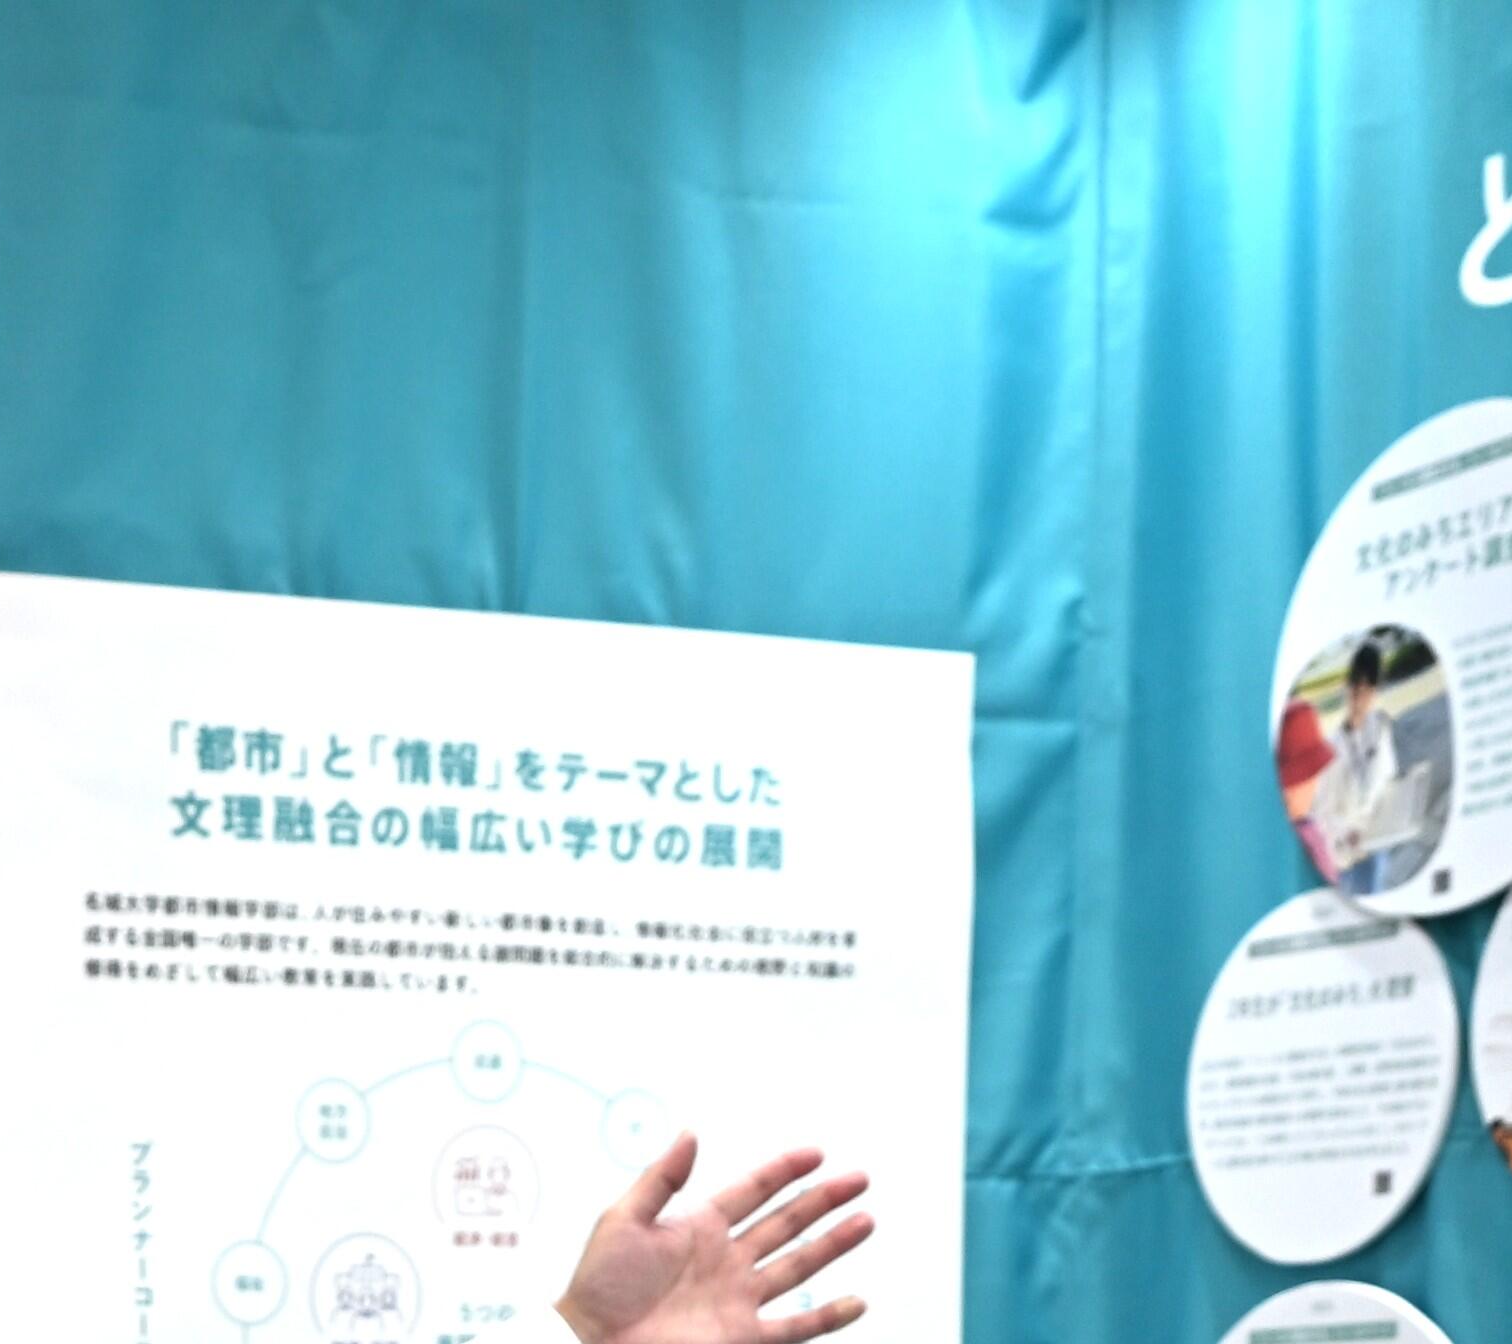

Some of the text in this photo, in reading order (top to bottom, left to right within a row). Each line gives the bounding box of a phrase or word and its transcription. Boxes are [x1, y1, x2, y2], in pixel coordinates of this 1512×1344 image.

[166, 719, 783, 810] 「都市」と「情報」をテーマとした
[169, 793, 785, 871] 文理融合の幅広い学びの展開
